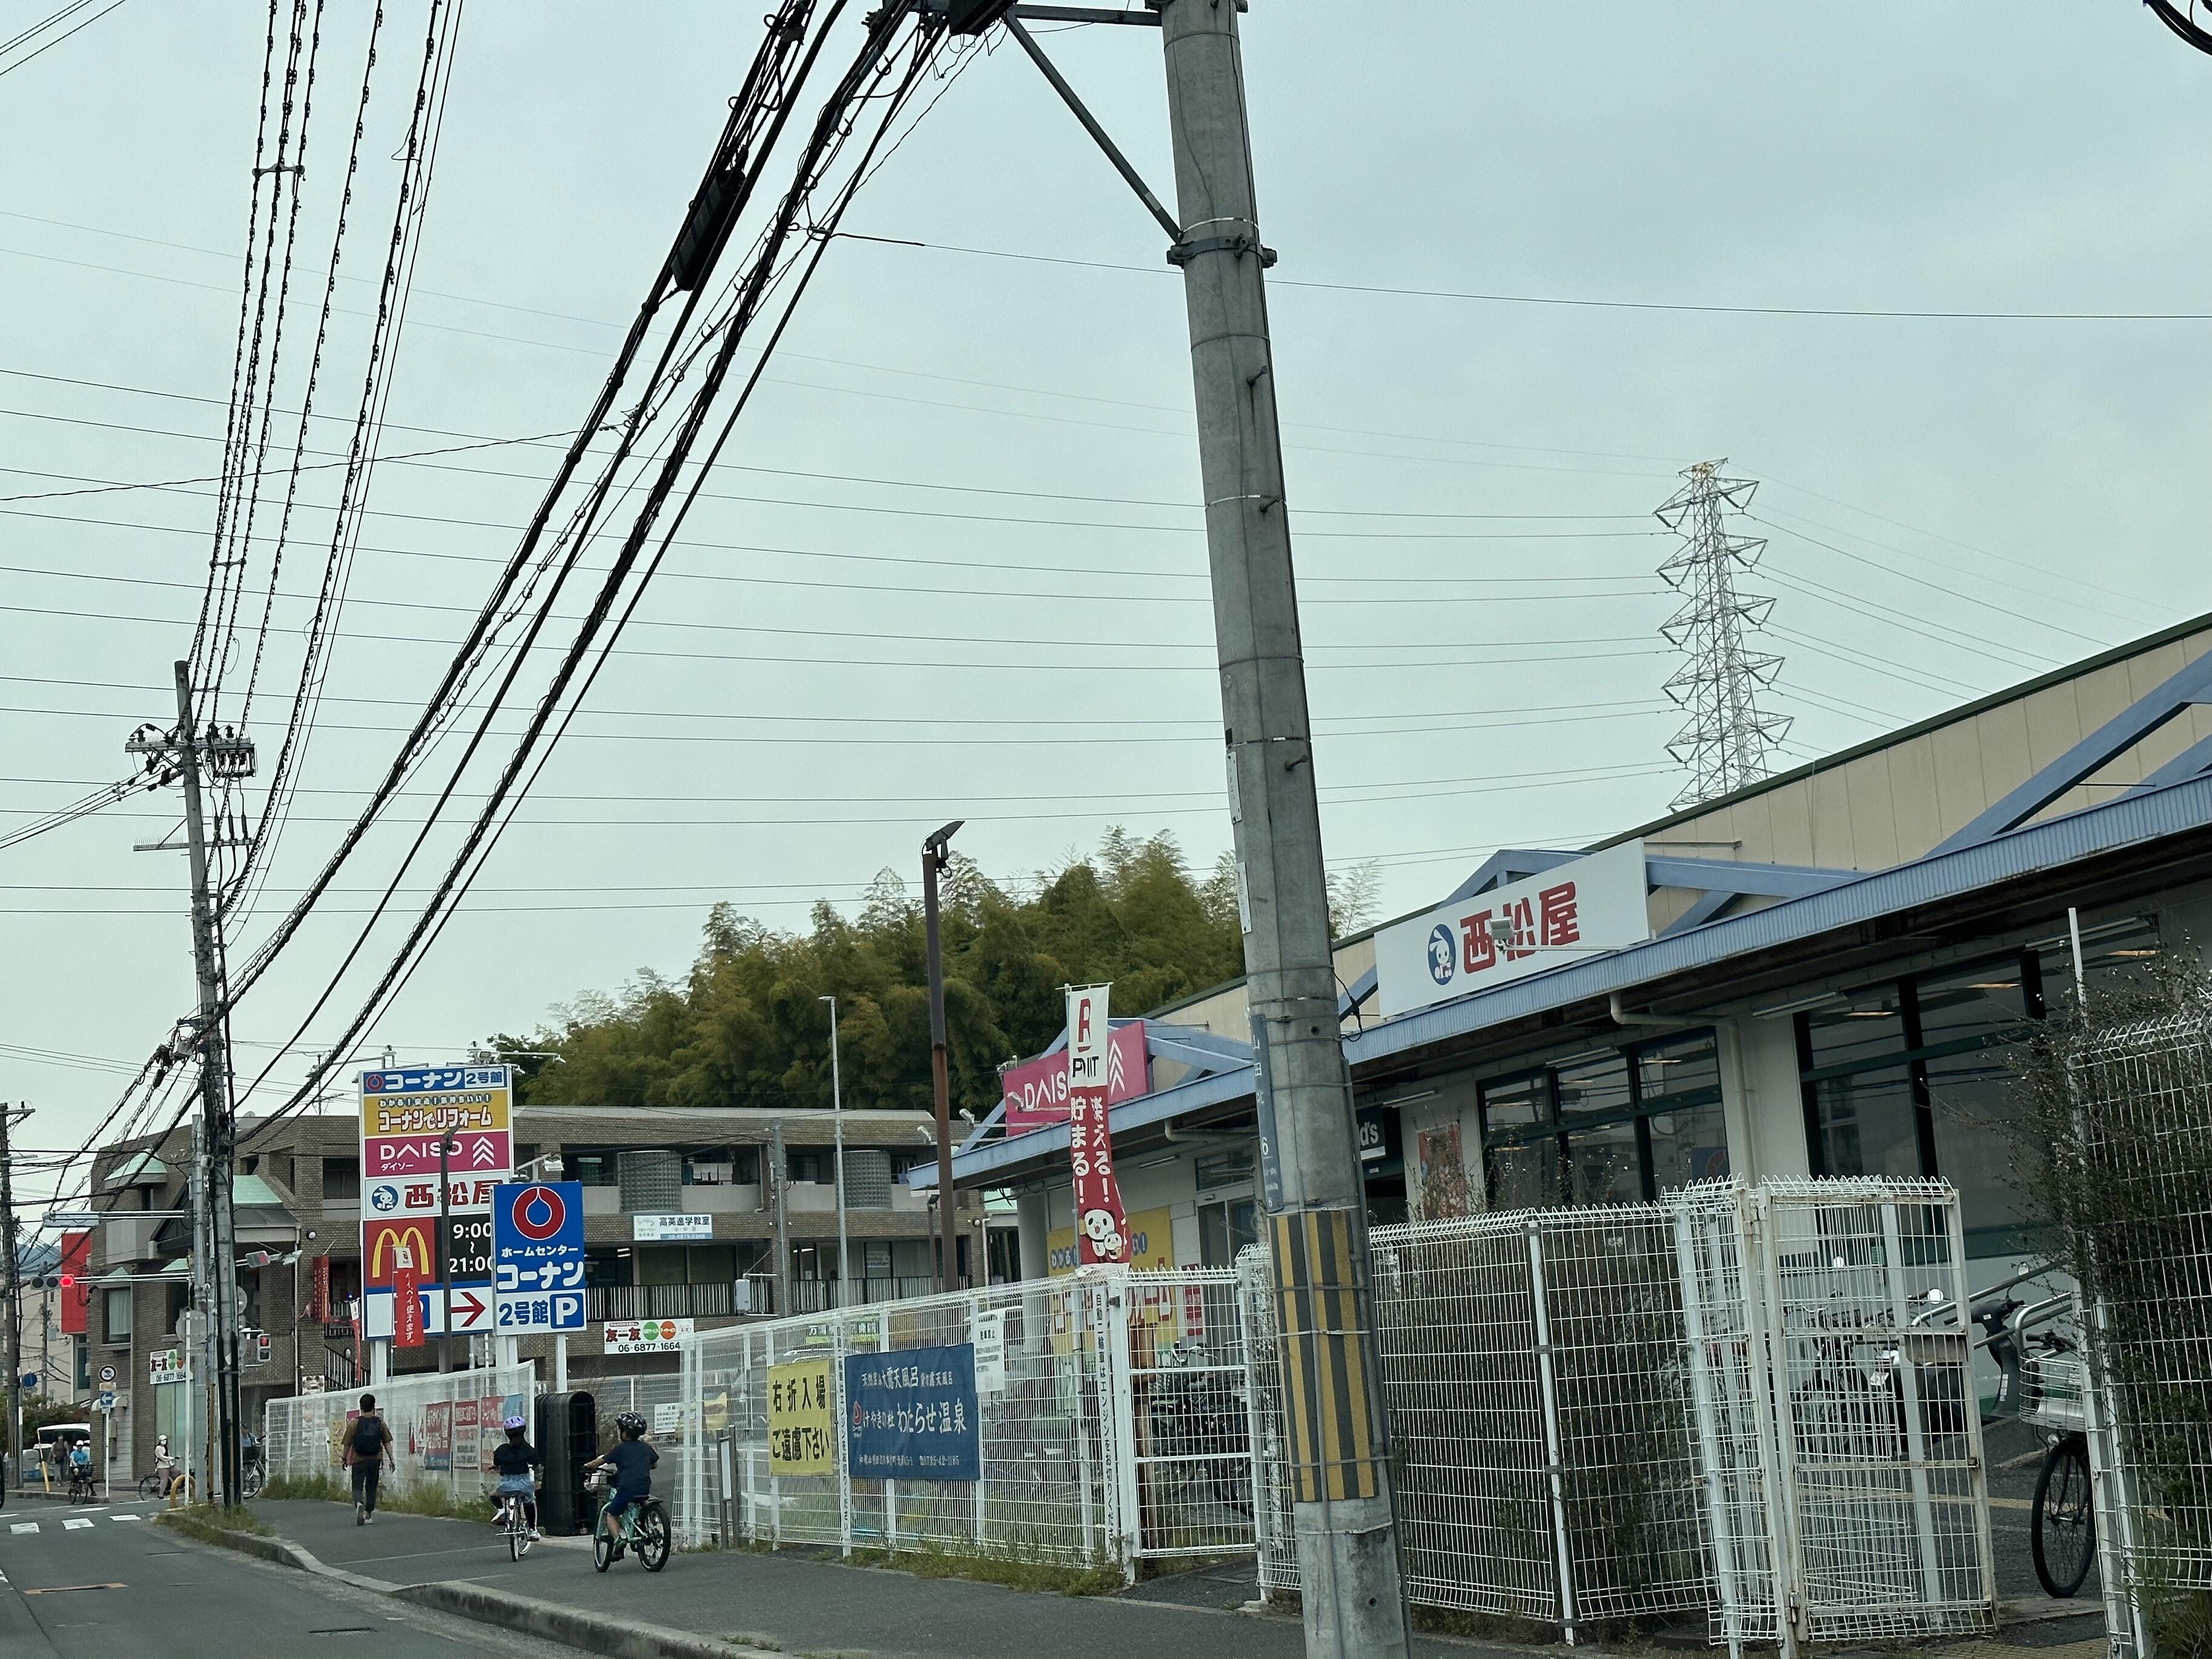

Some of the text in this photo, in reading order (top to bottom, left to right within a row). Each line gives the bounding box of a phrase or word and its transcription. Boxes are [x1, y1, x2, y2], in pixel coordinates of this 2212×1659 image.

[1460, 881, 1580, 974] 西松屋
[384, 1071, 503, 1090] コーナン 2号館
[1024, 1071, 1071, 1110] DAIS
[378, 1106, 493, 1132] コーナンでリフォーム
[380, 1141, 463, 1160] DAISO
[380, 1162, 414, 1172] ダイソー
[404, 1180, 503, 1209] 西松屋
[453, 1222, 491, 1239] 9:00
[501, 1245, 579, 1258] ホームセンター
[497, 1261, 584, 1290] コーナン
[499, 1297, 578, 1326] 2号館 P
[772, 1374, 826, 1413] 右折入場
[772, 1425, 829, 1461] ご遠慮下さい
